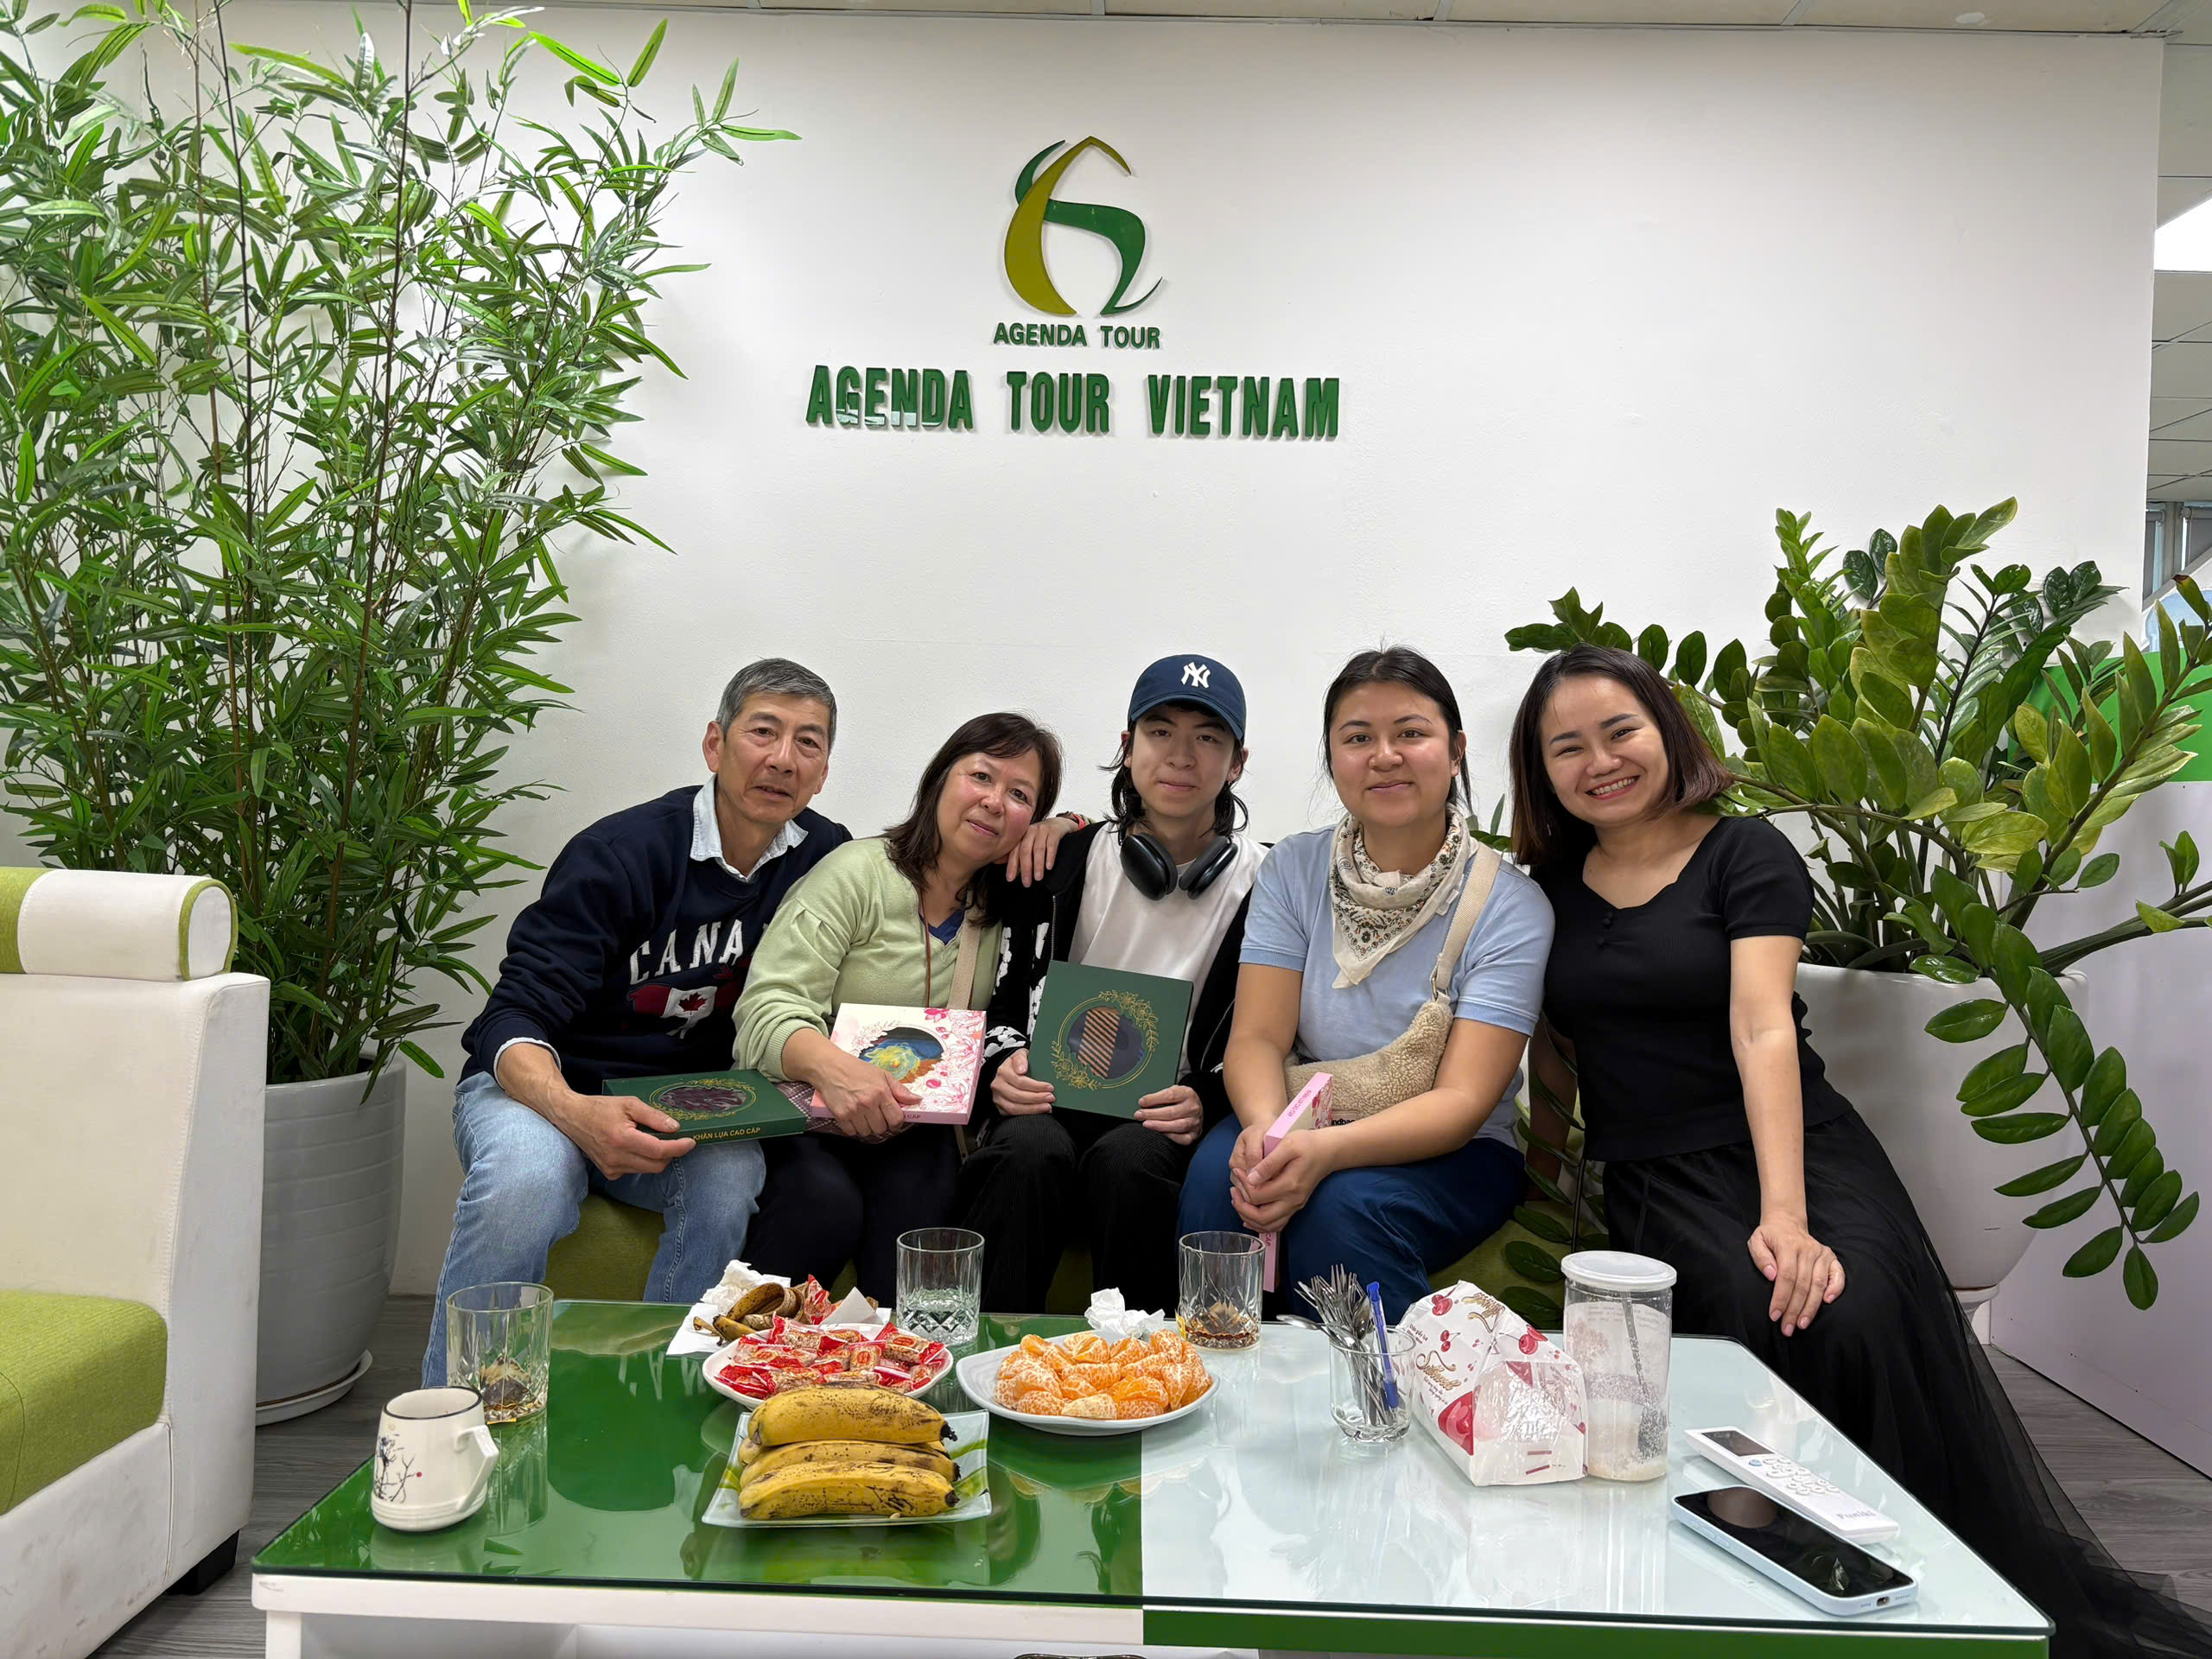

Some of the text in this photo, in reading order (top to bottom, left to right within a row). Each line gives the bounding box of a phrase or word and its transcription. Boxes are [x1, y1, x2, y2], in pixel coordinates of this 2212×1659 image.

[994, 322, 1160, 349] AGENDA TOUR
[805, 365, 1340, 437] AGENDA TOUR VIETNAM
[1180, 661, 1211, 689] NY
[630, 918, 768, 985] CANA
